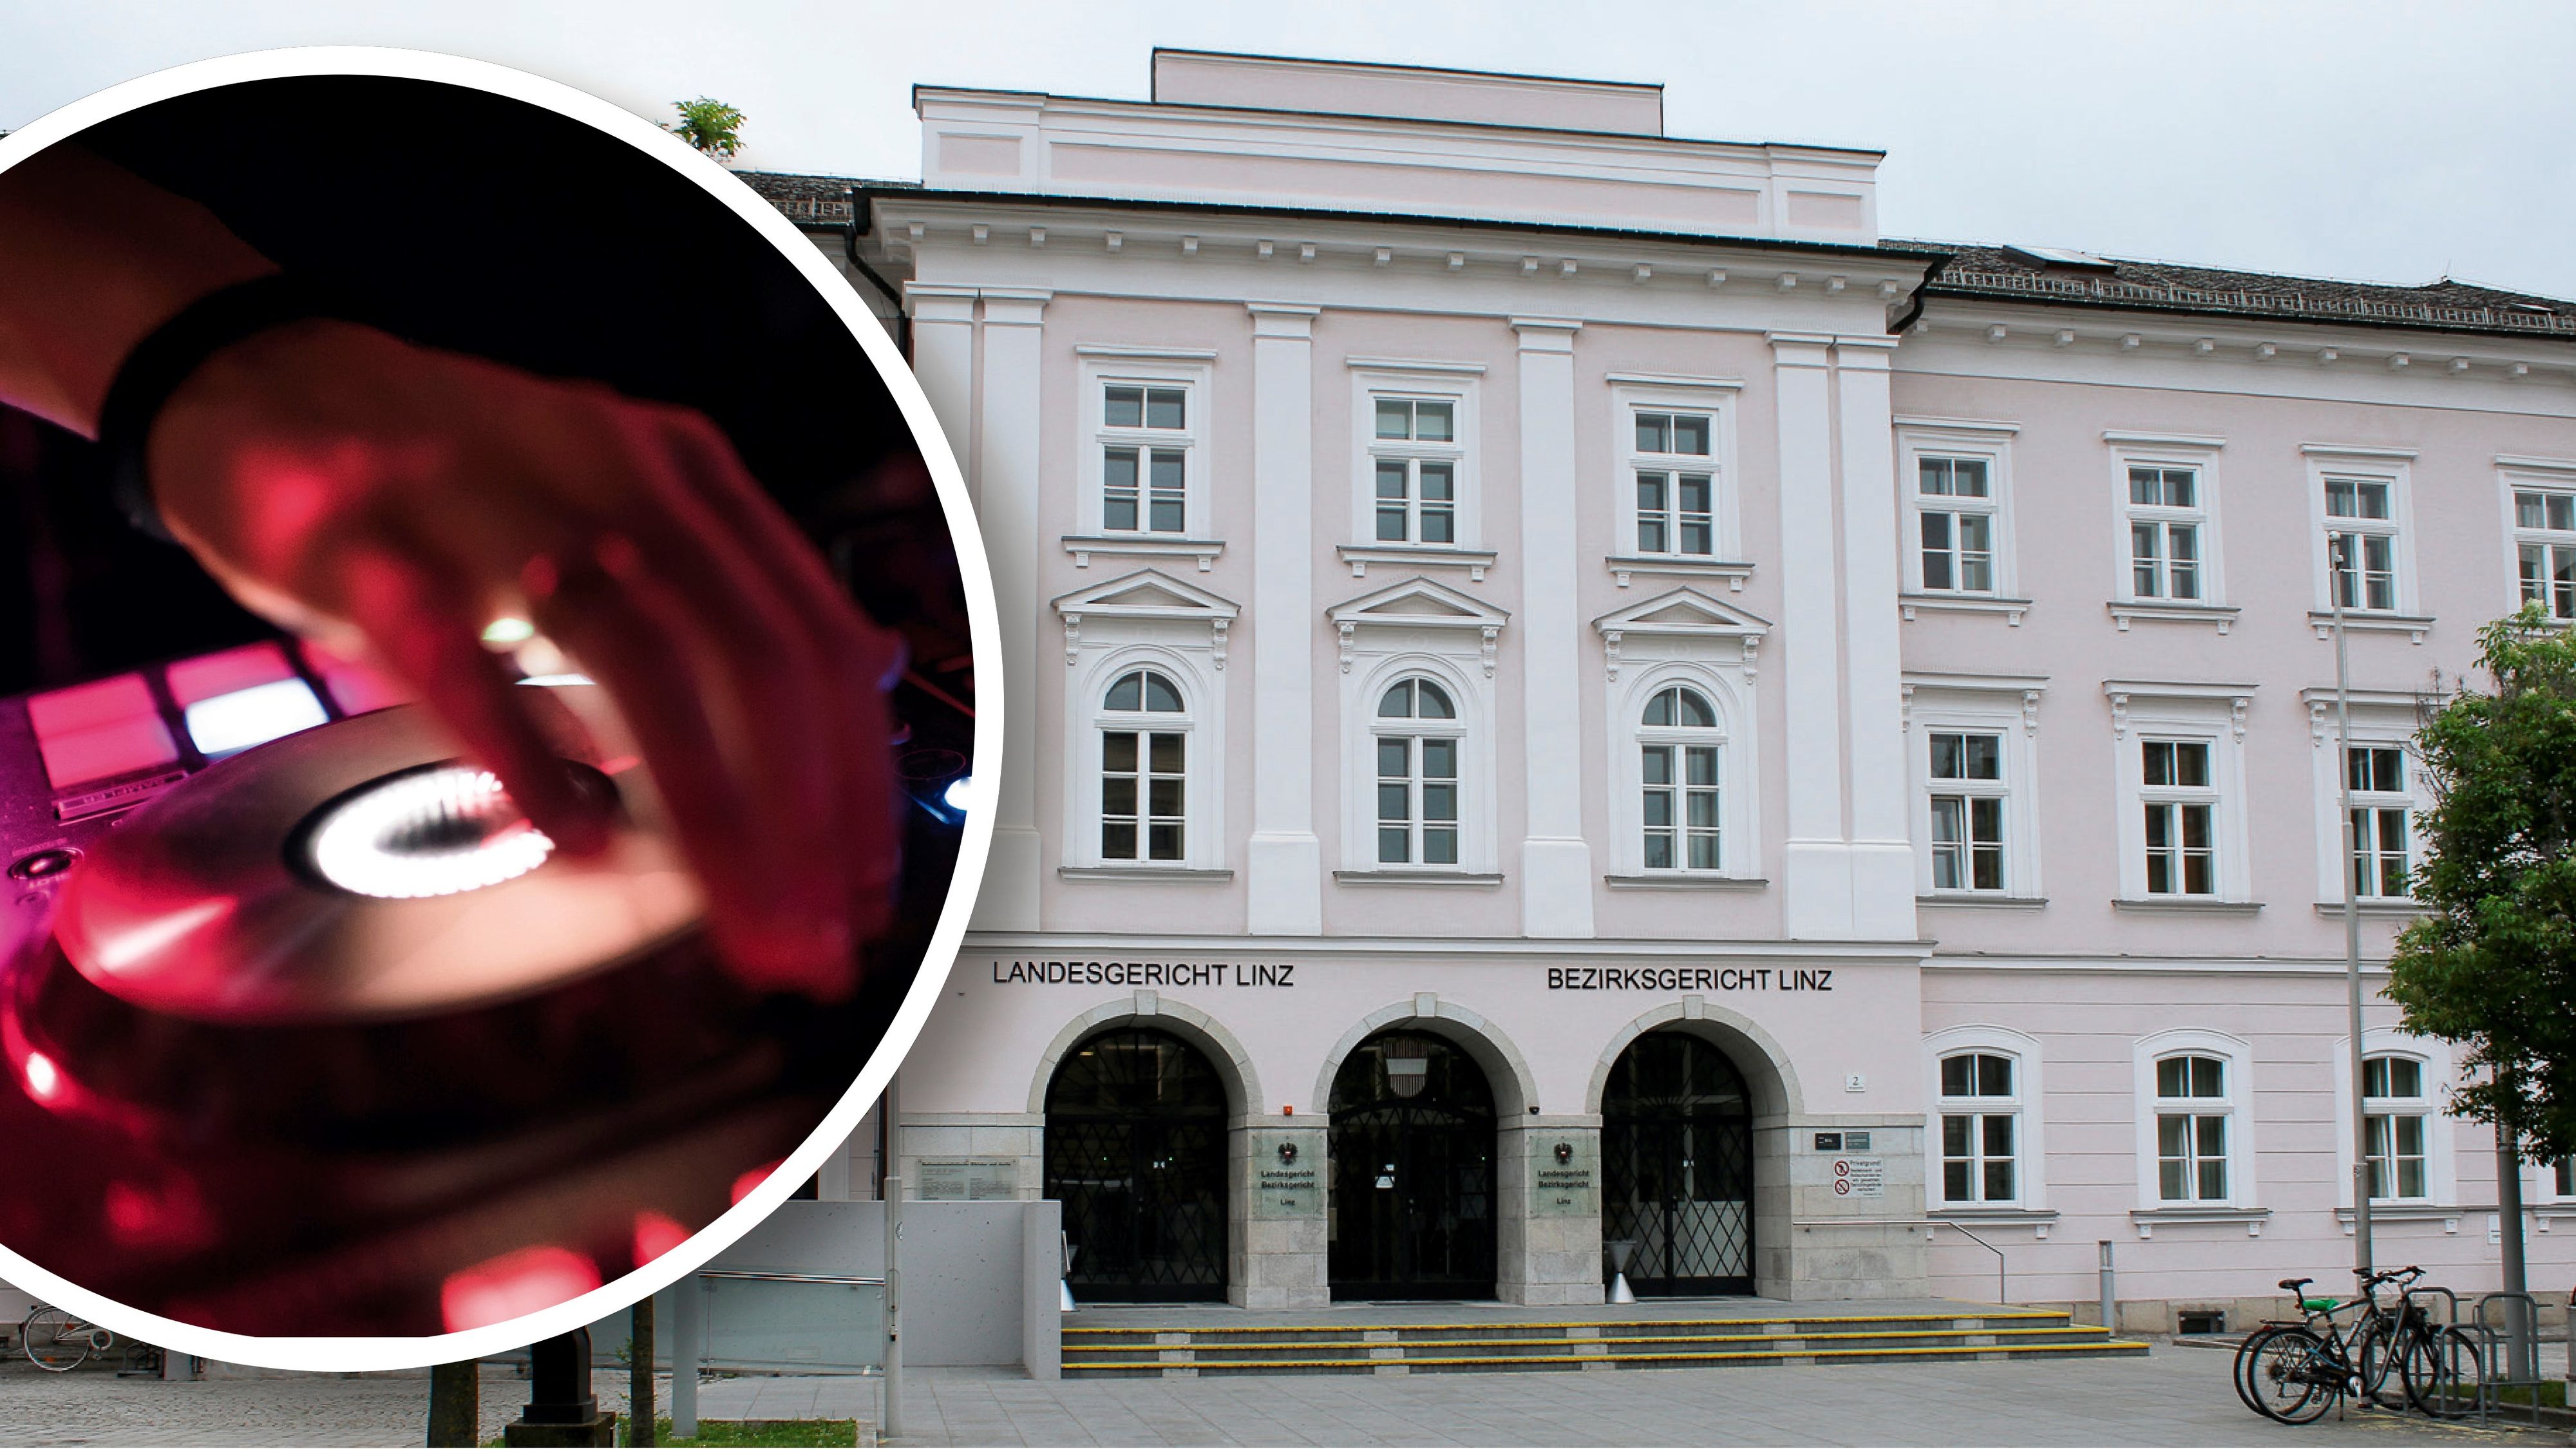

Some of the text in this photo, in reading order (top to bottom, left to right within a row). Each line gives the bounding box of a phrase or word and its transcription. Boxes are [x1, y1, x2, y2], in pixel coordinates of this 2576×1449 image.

[994, 961, 1294, 987] LANDESGERICHT LINZ
[1548, 968, 1833, 990] BEZIRKSGERICHT LINZ
[1853, 1076, 1858, 1086] 2
[1260, 1170, 1315, 1179] Landesgericht
[1538, 1170, 1589, 1178] Landesgericht
[1262, 1180, 1315, 1189] Bezirksgericht
[1538, 1180, 1589, 1189] Bezirksgericht
